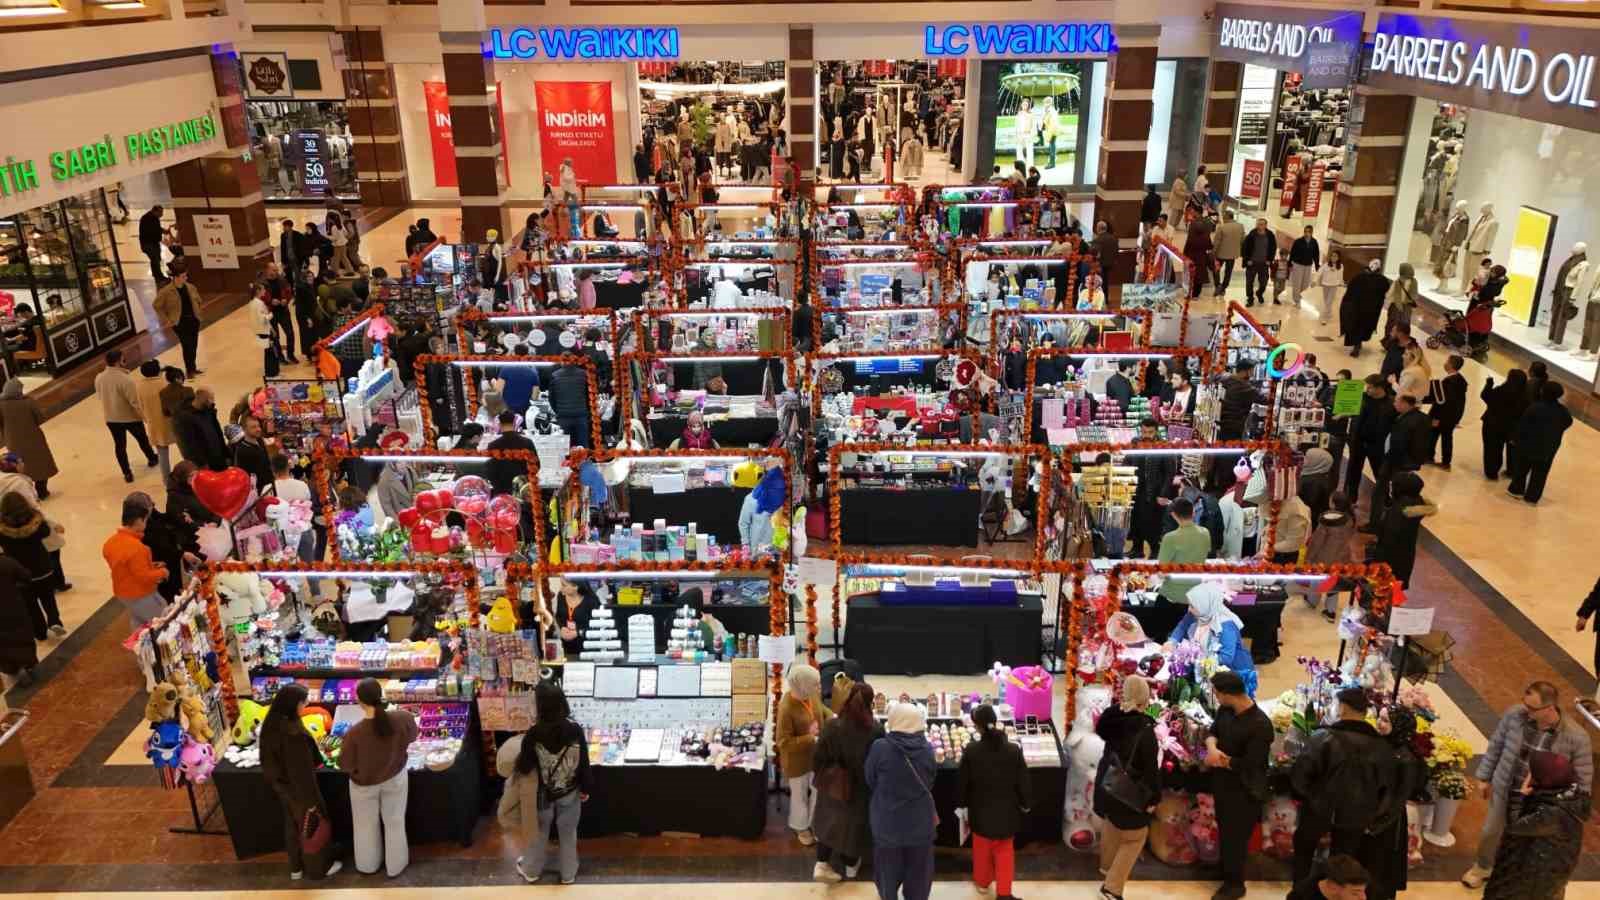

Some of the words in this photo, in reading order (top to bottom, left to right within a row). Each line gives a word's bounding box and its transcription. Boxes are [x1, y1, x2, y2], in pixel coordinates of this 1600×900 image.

[491, 27, 538, 58] LC
[925, 25, 970, 55] LC
[1220, 17, 1271, 53] BARRELS
[1268, 23, 1306, 58] AND
[1371, 32, 1466, 85] BARRELS
[1465, 44, 1537, 95] AND
[1543, 52, 1599, 108] OIL
[545, 109, 607, 127] İNDİRİM
[50, 134, 117, 182] SABRİ
[125, 104, 217, 161] PASTANESİ
[305, 162, 325, 178] 50
[1245, 171, 1261, 186] 50
[1282, 163, 1298, 200] SALE
